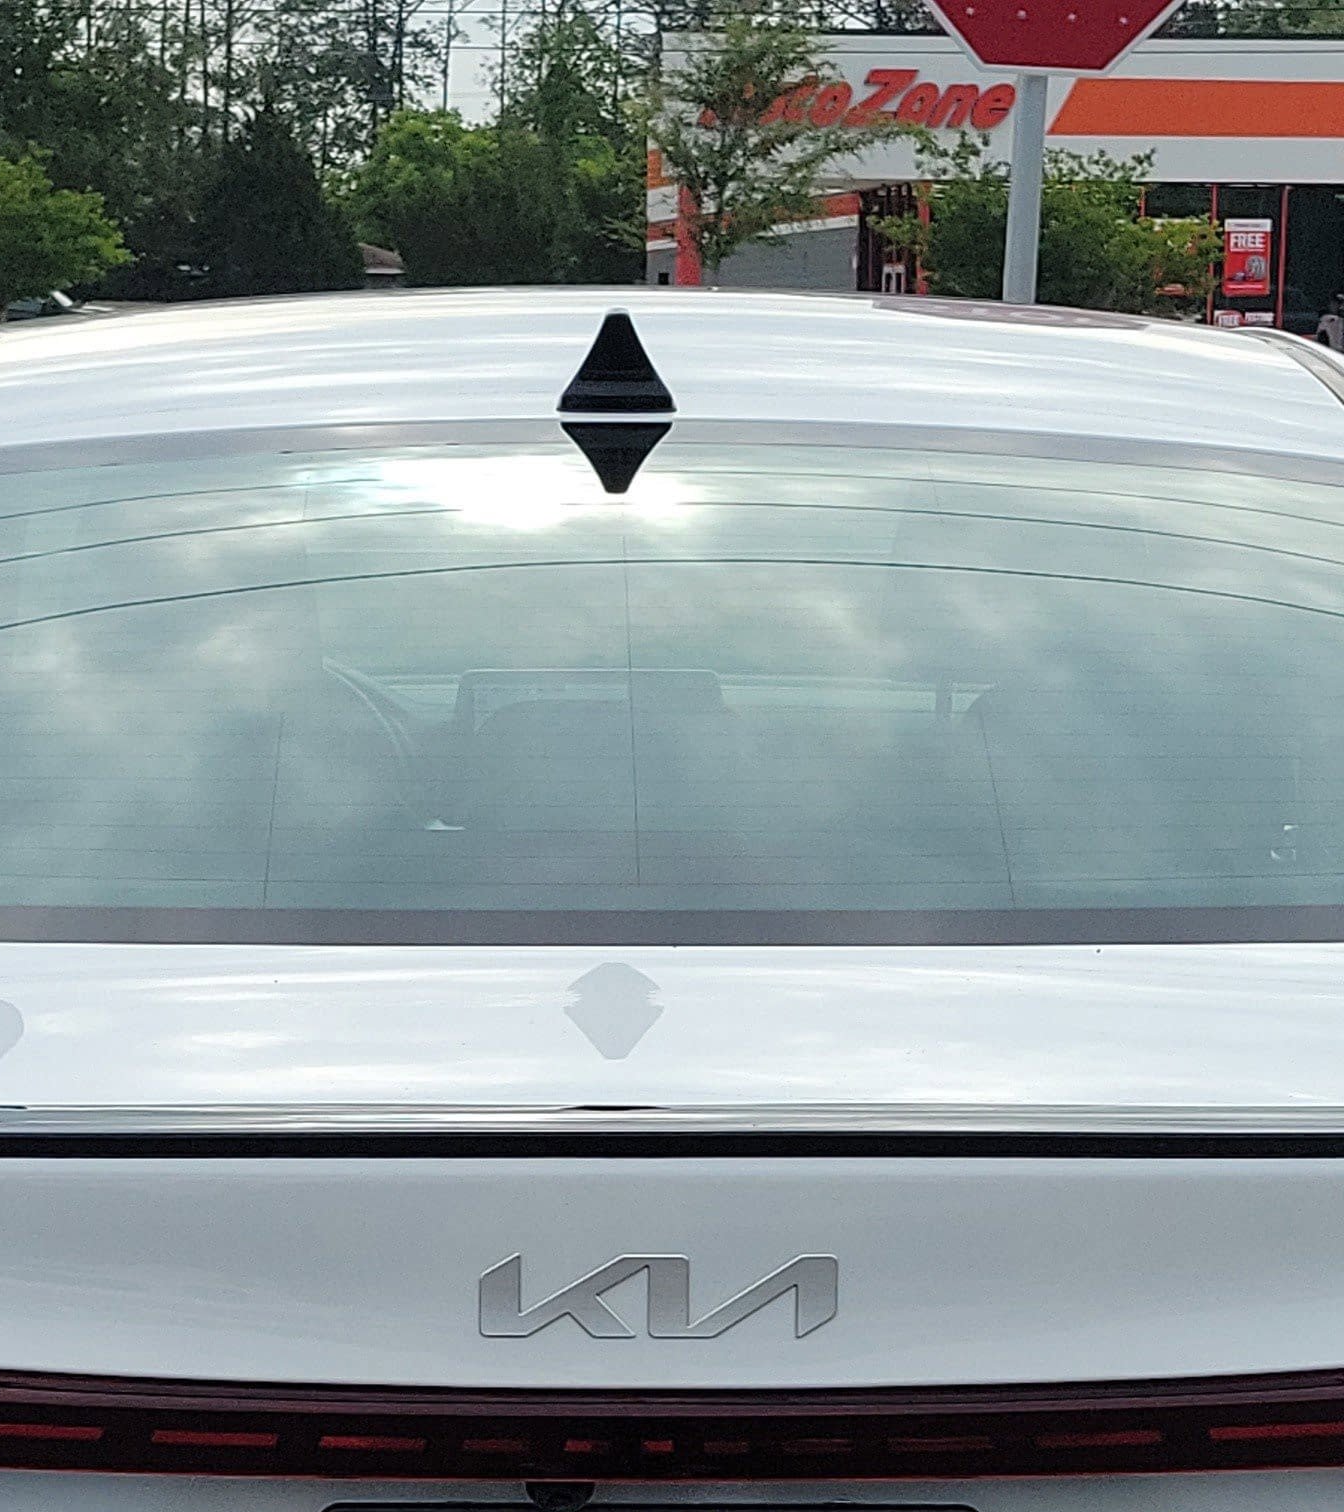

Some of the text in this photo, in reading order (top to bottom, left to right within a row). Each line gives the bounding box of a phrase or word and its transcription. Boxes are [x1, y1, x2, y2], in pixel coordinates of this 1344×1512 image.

[697, 68, 1017, 130] toZone
[1230, 233, 1266, 249] FREE
[479, 1252, 839, 1339] KIA
